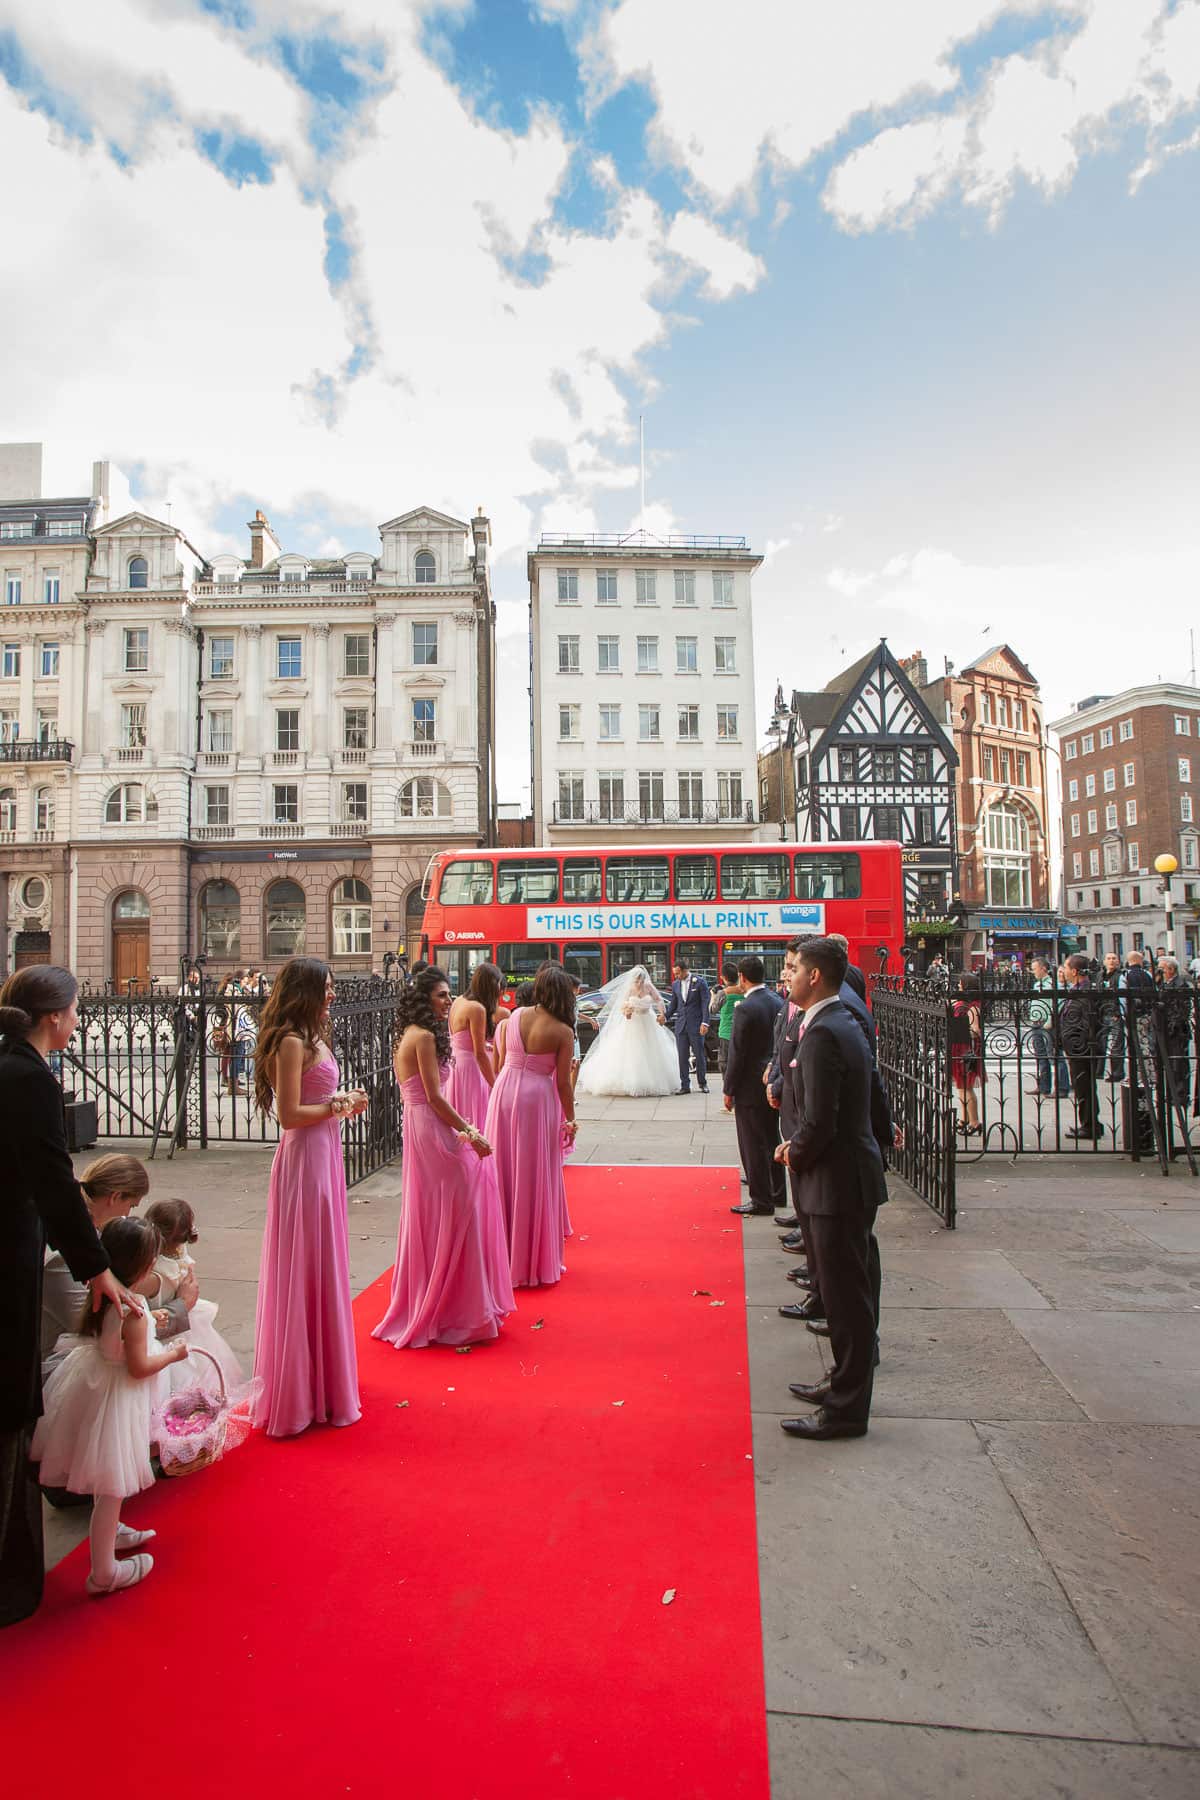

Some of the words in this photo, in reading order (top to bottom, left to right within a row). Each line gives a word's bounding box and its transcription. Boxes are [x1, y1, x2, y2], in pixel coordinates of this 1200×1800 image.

[782, 907, 817, 917] wonga
[588, 914, 604, 930] IS
[609, 913, 646, 930] OUR
[650, 912, 712, 929] SMALL
[716, 912, 772, 928] PRINT.
[1008, 917, 1043, 928] NEWS
